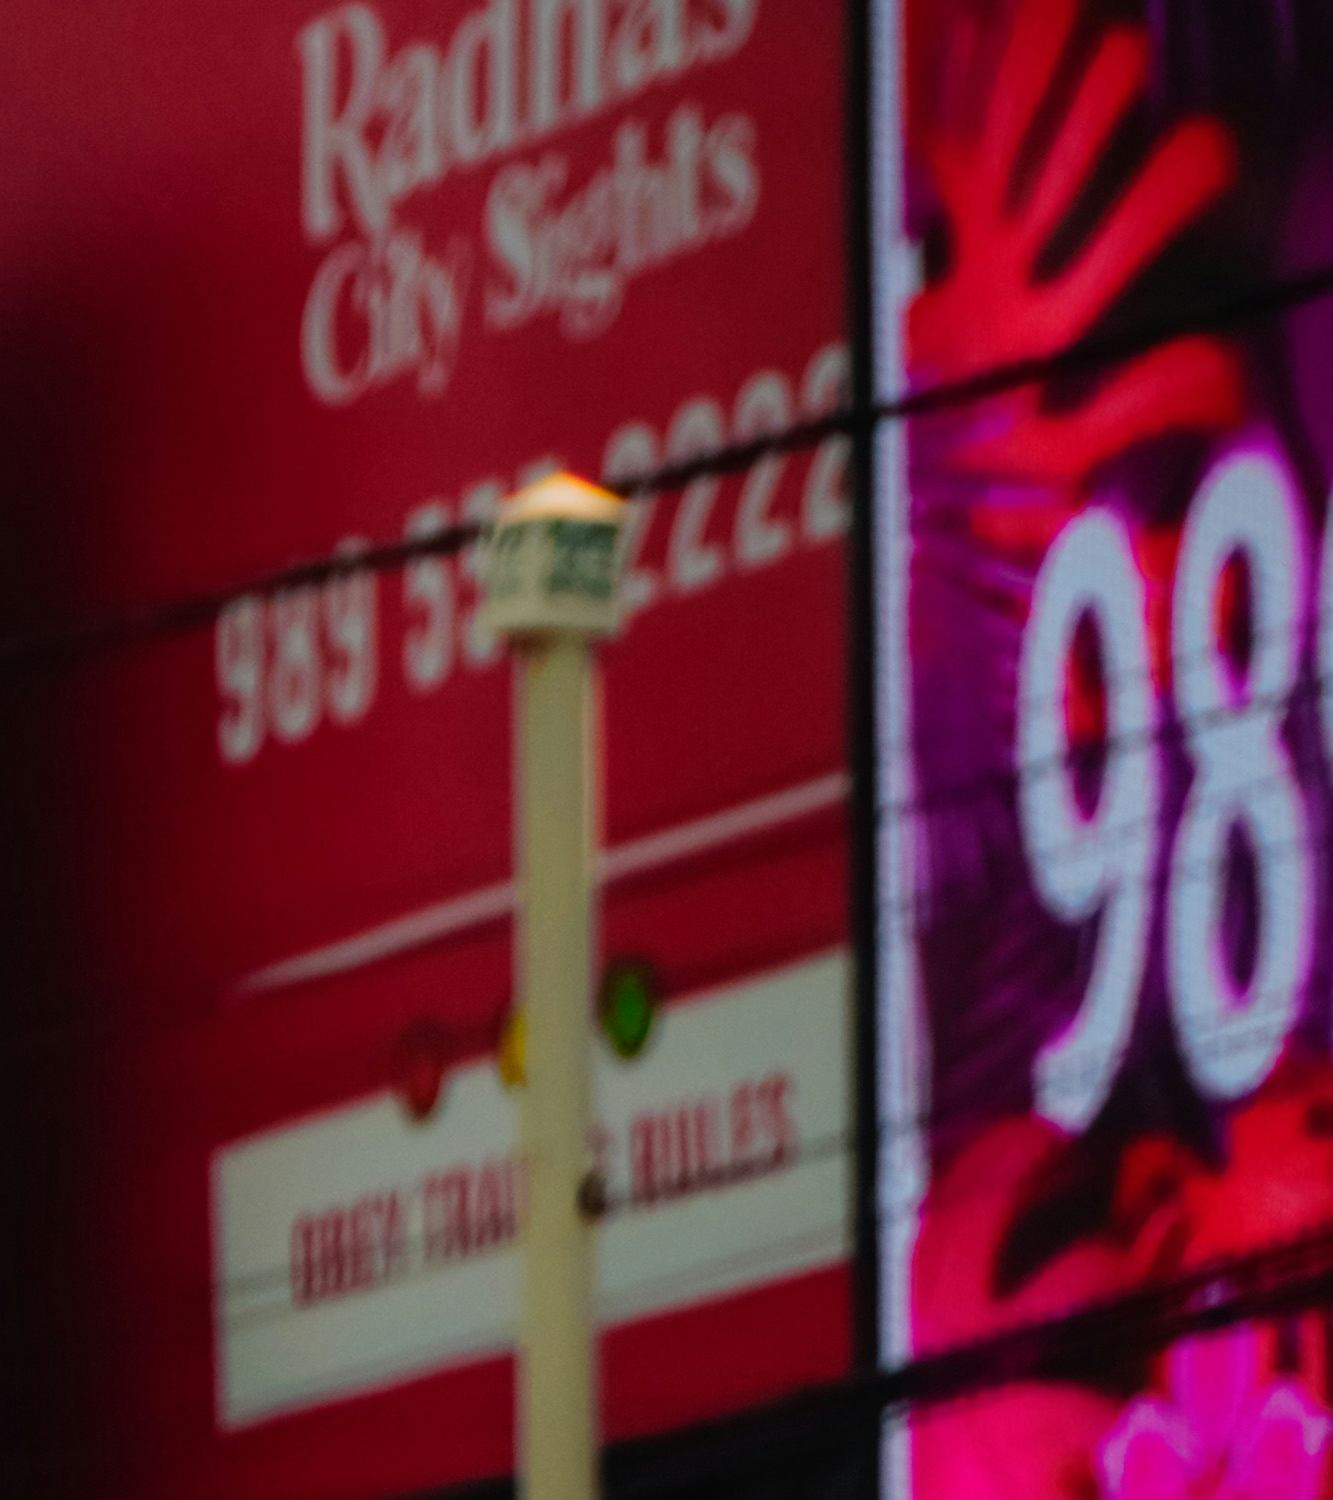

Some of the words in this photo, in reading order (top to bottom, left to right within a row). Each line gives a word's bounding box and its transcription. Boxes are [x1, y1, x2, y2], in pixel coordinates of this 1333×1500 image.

[300, 228, 473, 408] City
[483, 102, 761, 340] Sights
[215, 535, 379, 766] 989
[1015, 445, 1333, 1135] 98
